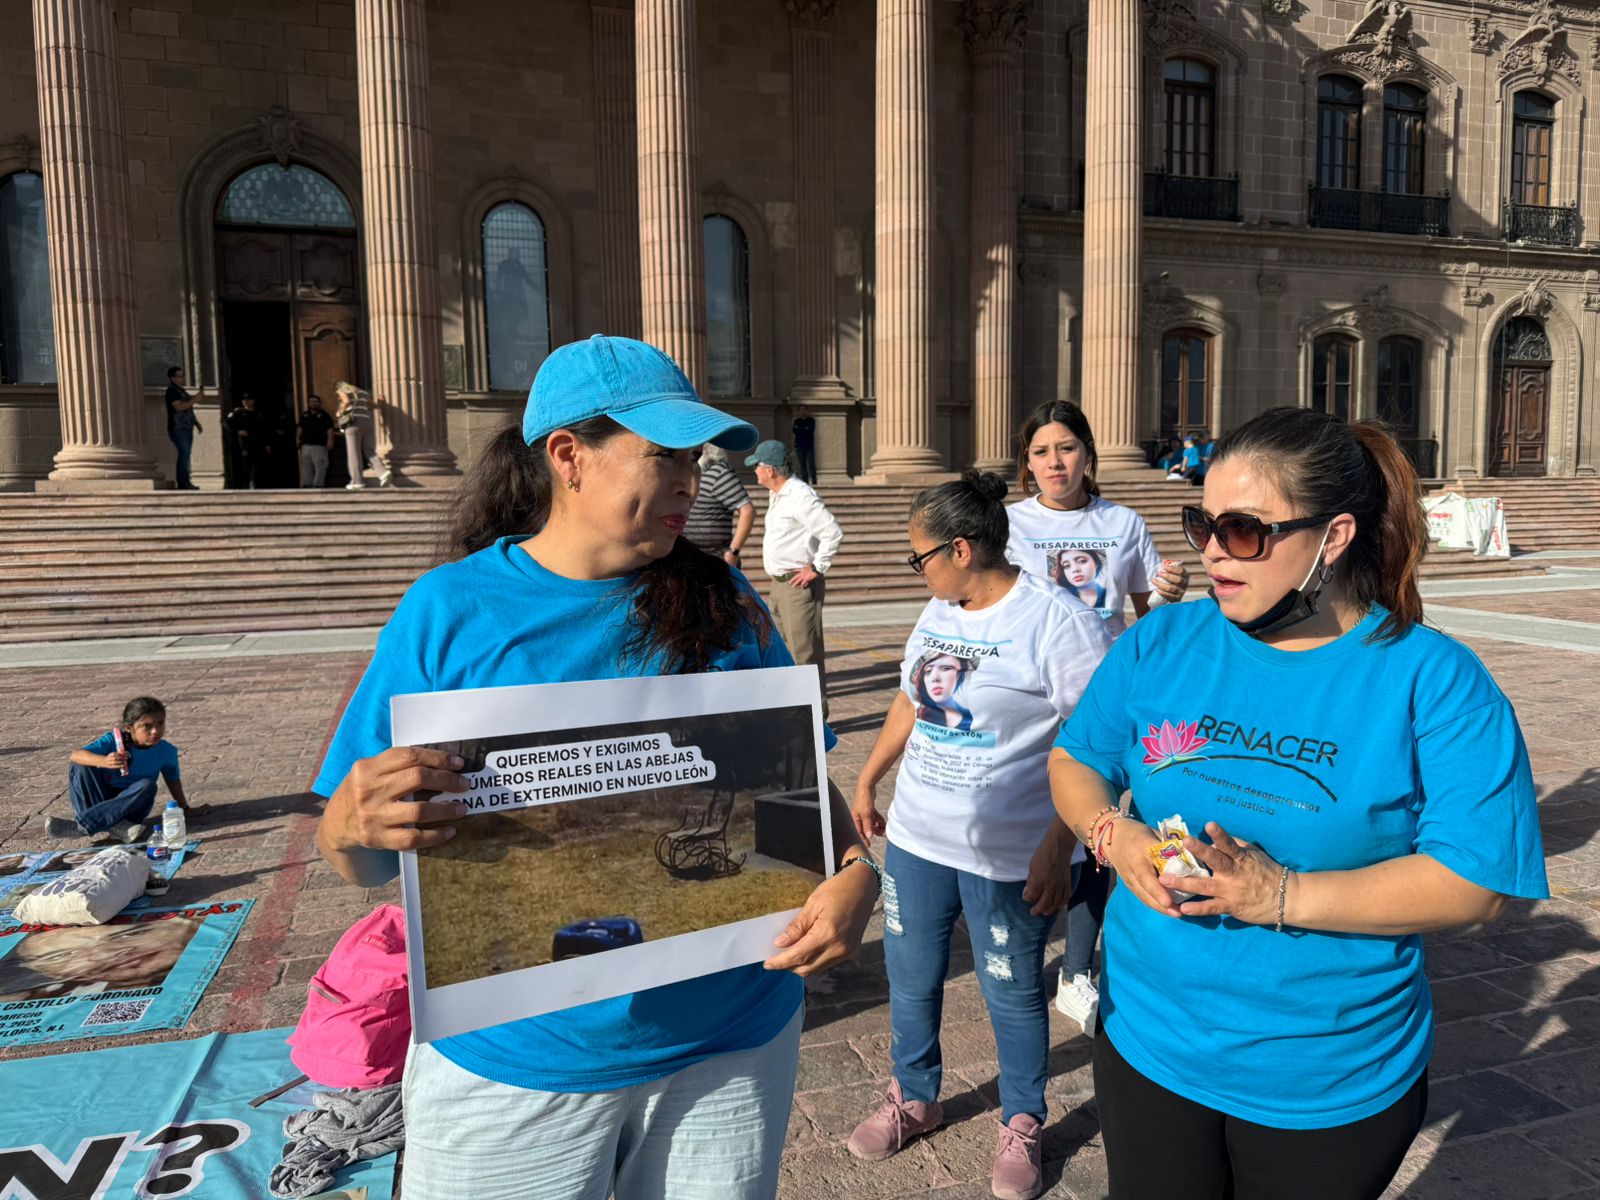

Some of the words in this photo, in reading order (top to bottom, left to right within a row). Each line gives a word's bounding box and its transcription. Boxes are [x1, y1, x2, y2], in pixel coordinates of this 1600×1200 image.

[1033, 540, 1119, 550] DESAPARECIDA
[496, 747, 580, 769] QUEREMOS
[583, 746, 592, 758] Y
[596, 738, 661, 757] EXIGIMOS
[1195, 714, 1339, 768] RENACER
[469, 770, 535, 791] ÚMEROS
[538, 763, 592, 782] REALES
[596, 761, 614, 774] EN
[617, 757, 642, 771] LAS
[645, 750, 694, 768] ABEJAS
[489, 792, 510, 807] DE
[513, 780, 603, 803] EXTERMINIO
[606, 777, 625, 790] EN
[627, 770, 673, 788] NUEVO
[675, 763, 708, 781] LEÓN
[1182, 766, 1197, 777] Por
[1199, 773, 1243, 792] nuestros
[3, 996, 78, 1011] CASTILLO
[80, 986, 164, 1002] CORONADO
